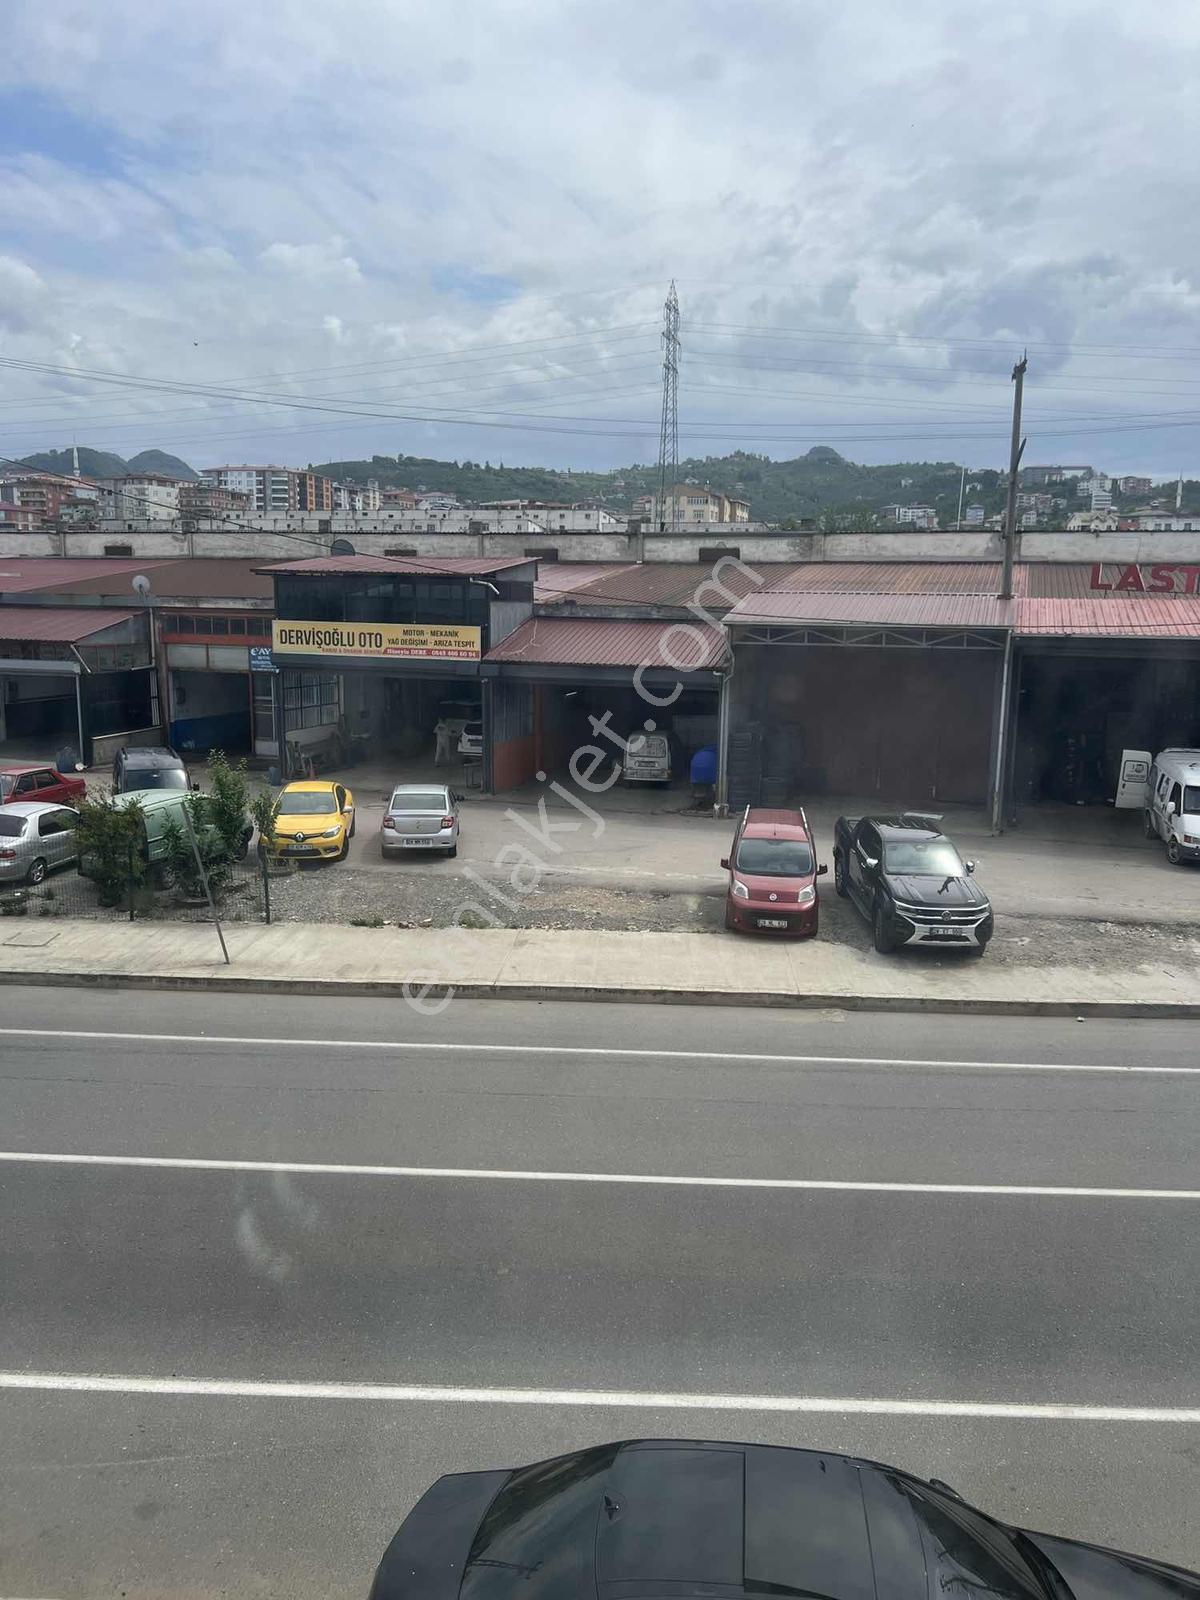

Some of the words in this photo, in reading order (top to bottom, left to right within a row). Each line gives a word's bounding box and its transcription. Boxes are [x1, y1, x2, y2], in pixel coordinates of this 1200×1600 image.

[280, 627, 354, 648] DERVİŞOĞLU
[359, 632, 382, 648] OTO
[430, 629, 460, 637] MEKANİK
